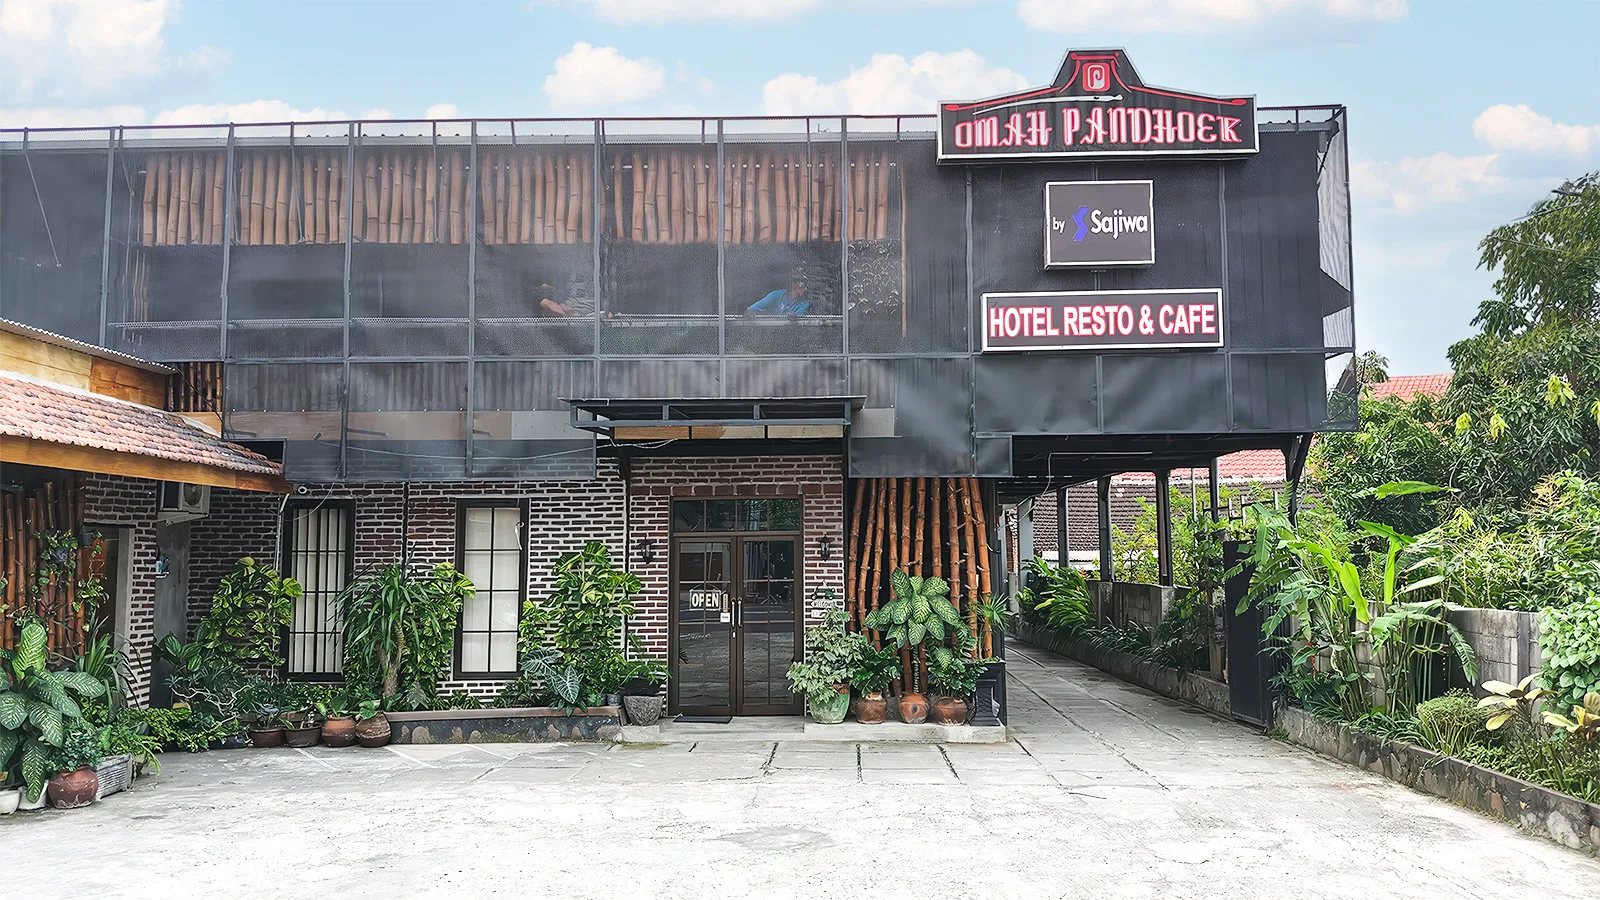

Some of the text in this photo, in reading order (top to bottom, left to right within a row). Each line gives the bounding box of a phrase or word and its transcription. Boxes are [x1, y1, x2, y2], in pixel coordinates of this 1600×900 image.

[954, 110, 1053, 148] OMAH
[1052, 209, 1148, 239] by Sajiwa
[989, 303, 1216, 337] HOTEL RESTO & CAFE
[691, 592, 719, 608] OPEN
